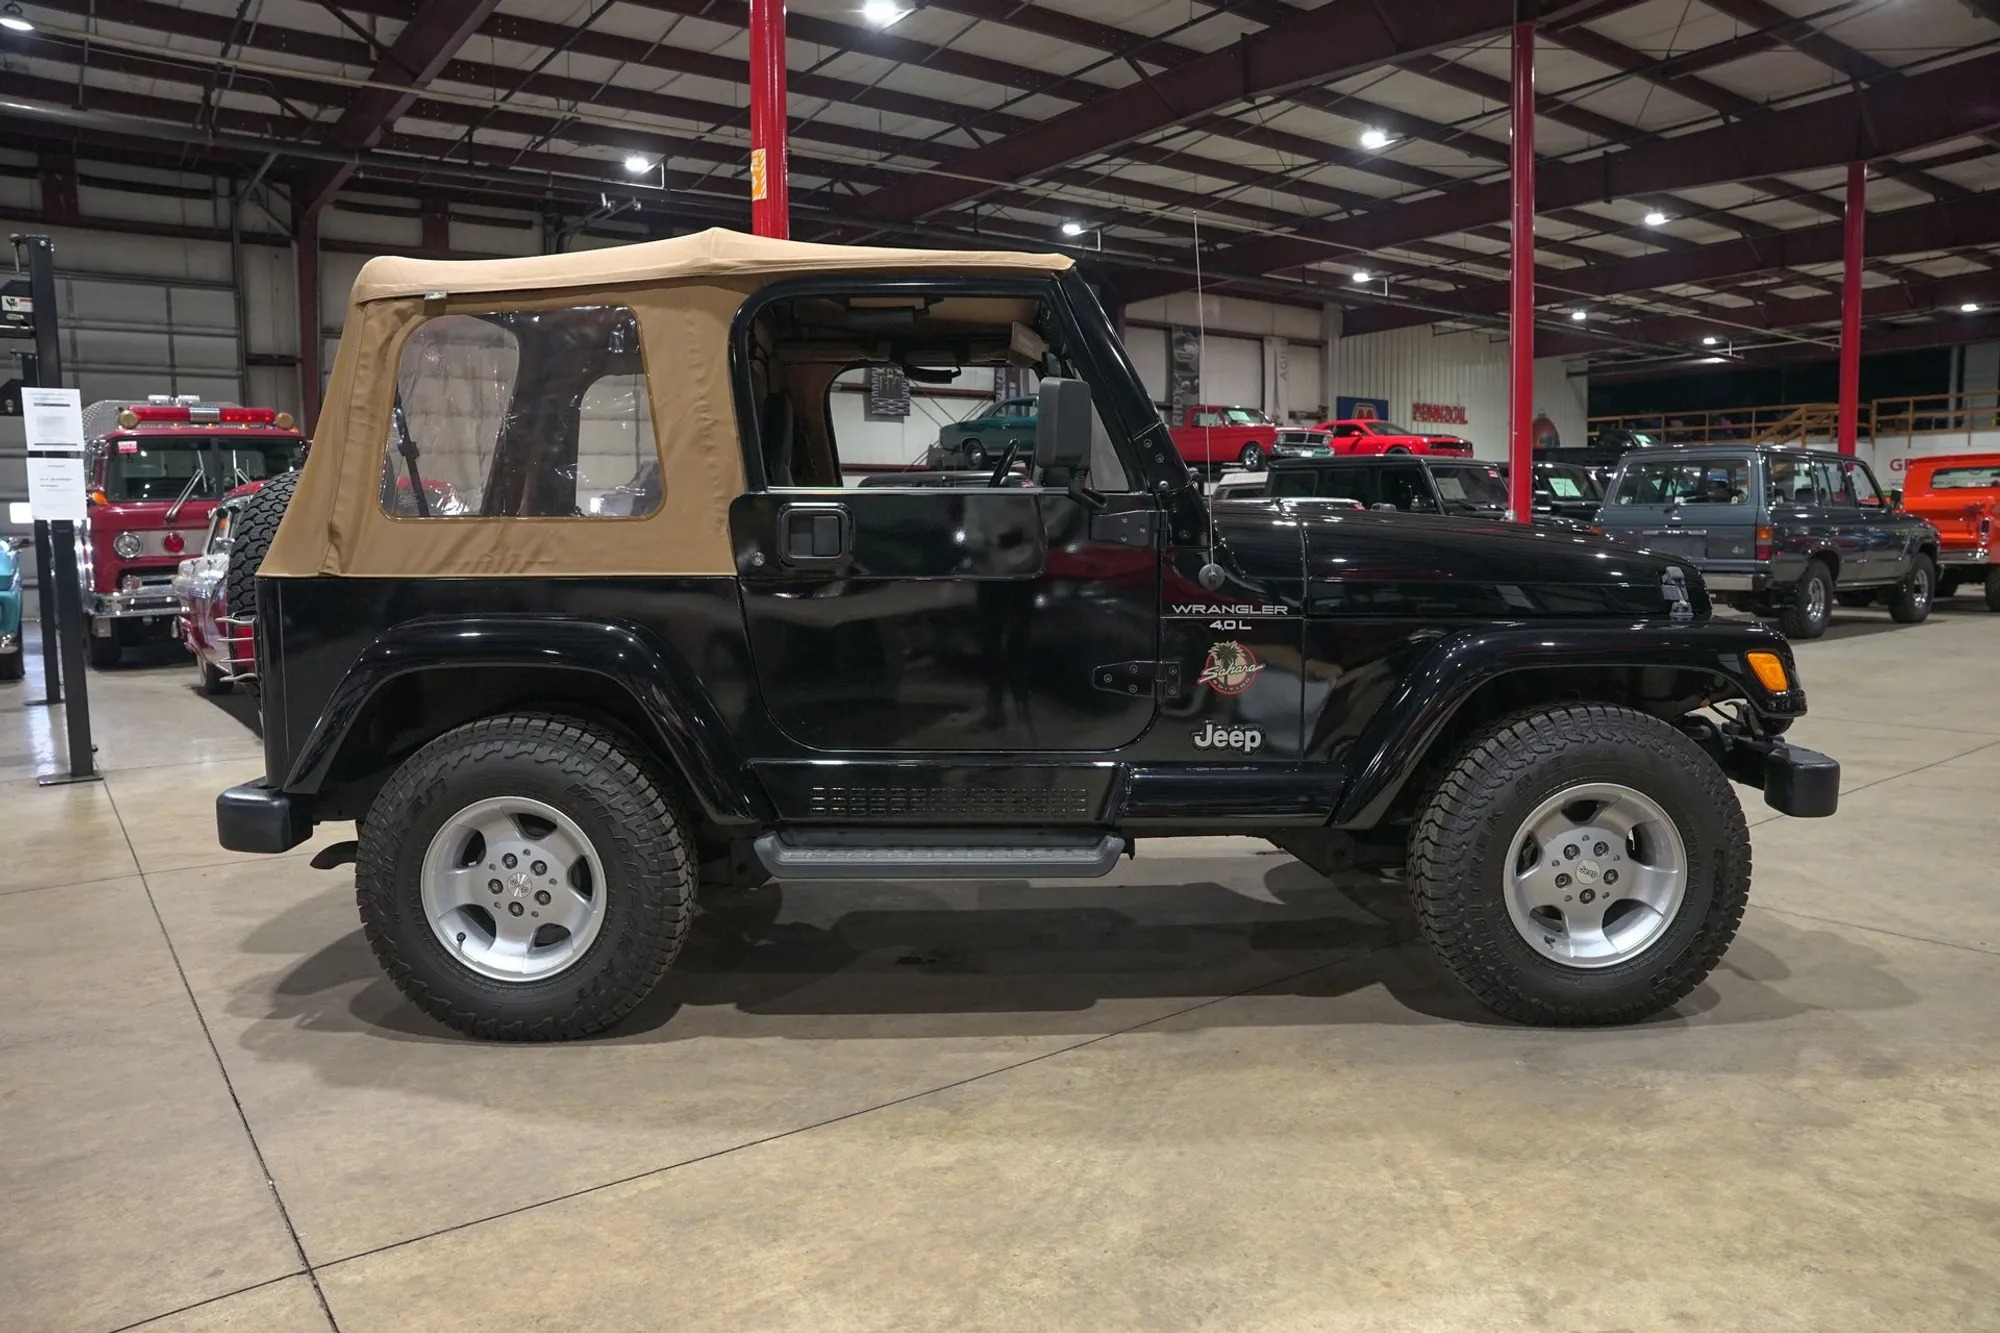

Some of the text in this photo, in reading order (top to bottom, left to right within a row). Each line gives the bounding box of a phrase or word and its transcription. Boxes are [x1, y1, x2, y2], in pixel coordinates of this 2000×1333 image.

[1172, 604, 1288, 615] WRANGLER
[1199, 660, 1266, 684] Sahara
[1213, 677, 1250, 692] EDITION
[1194, 724, 1262, 752] Jeep
